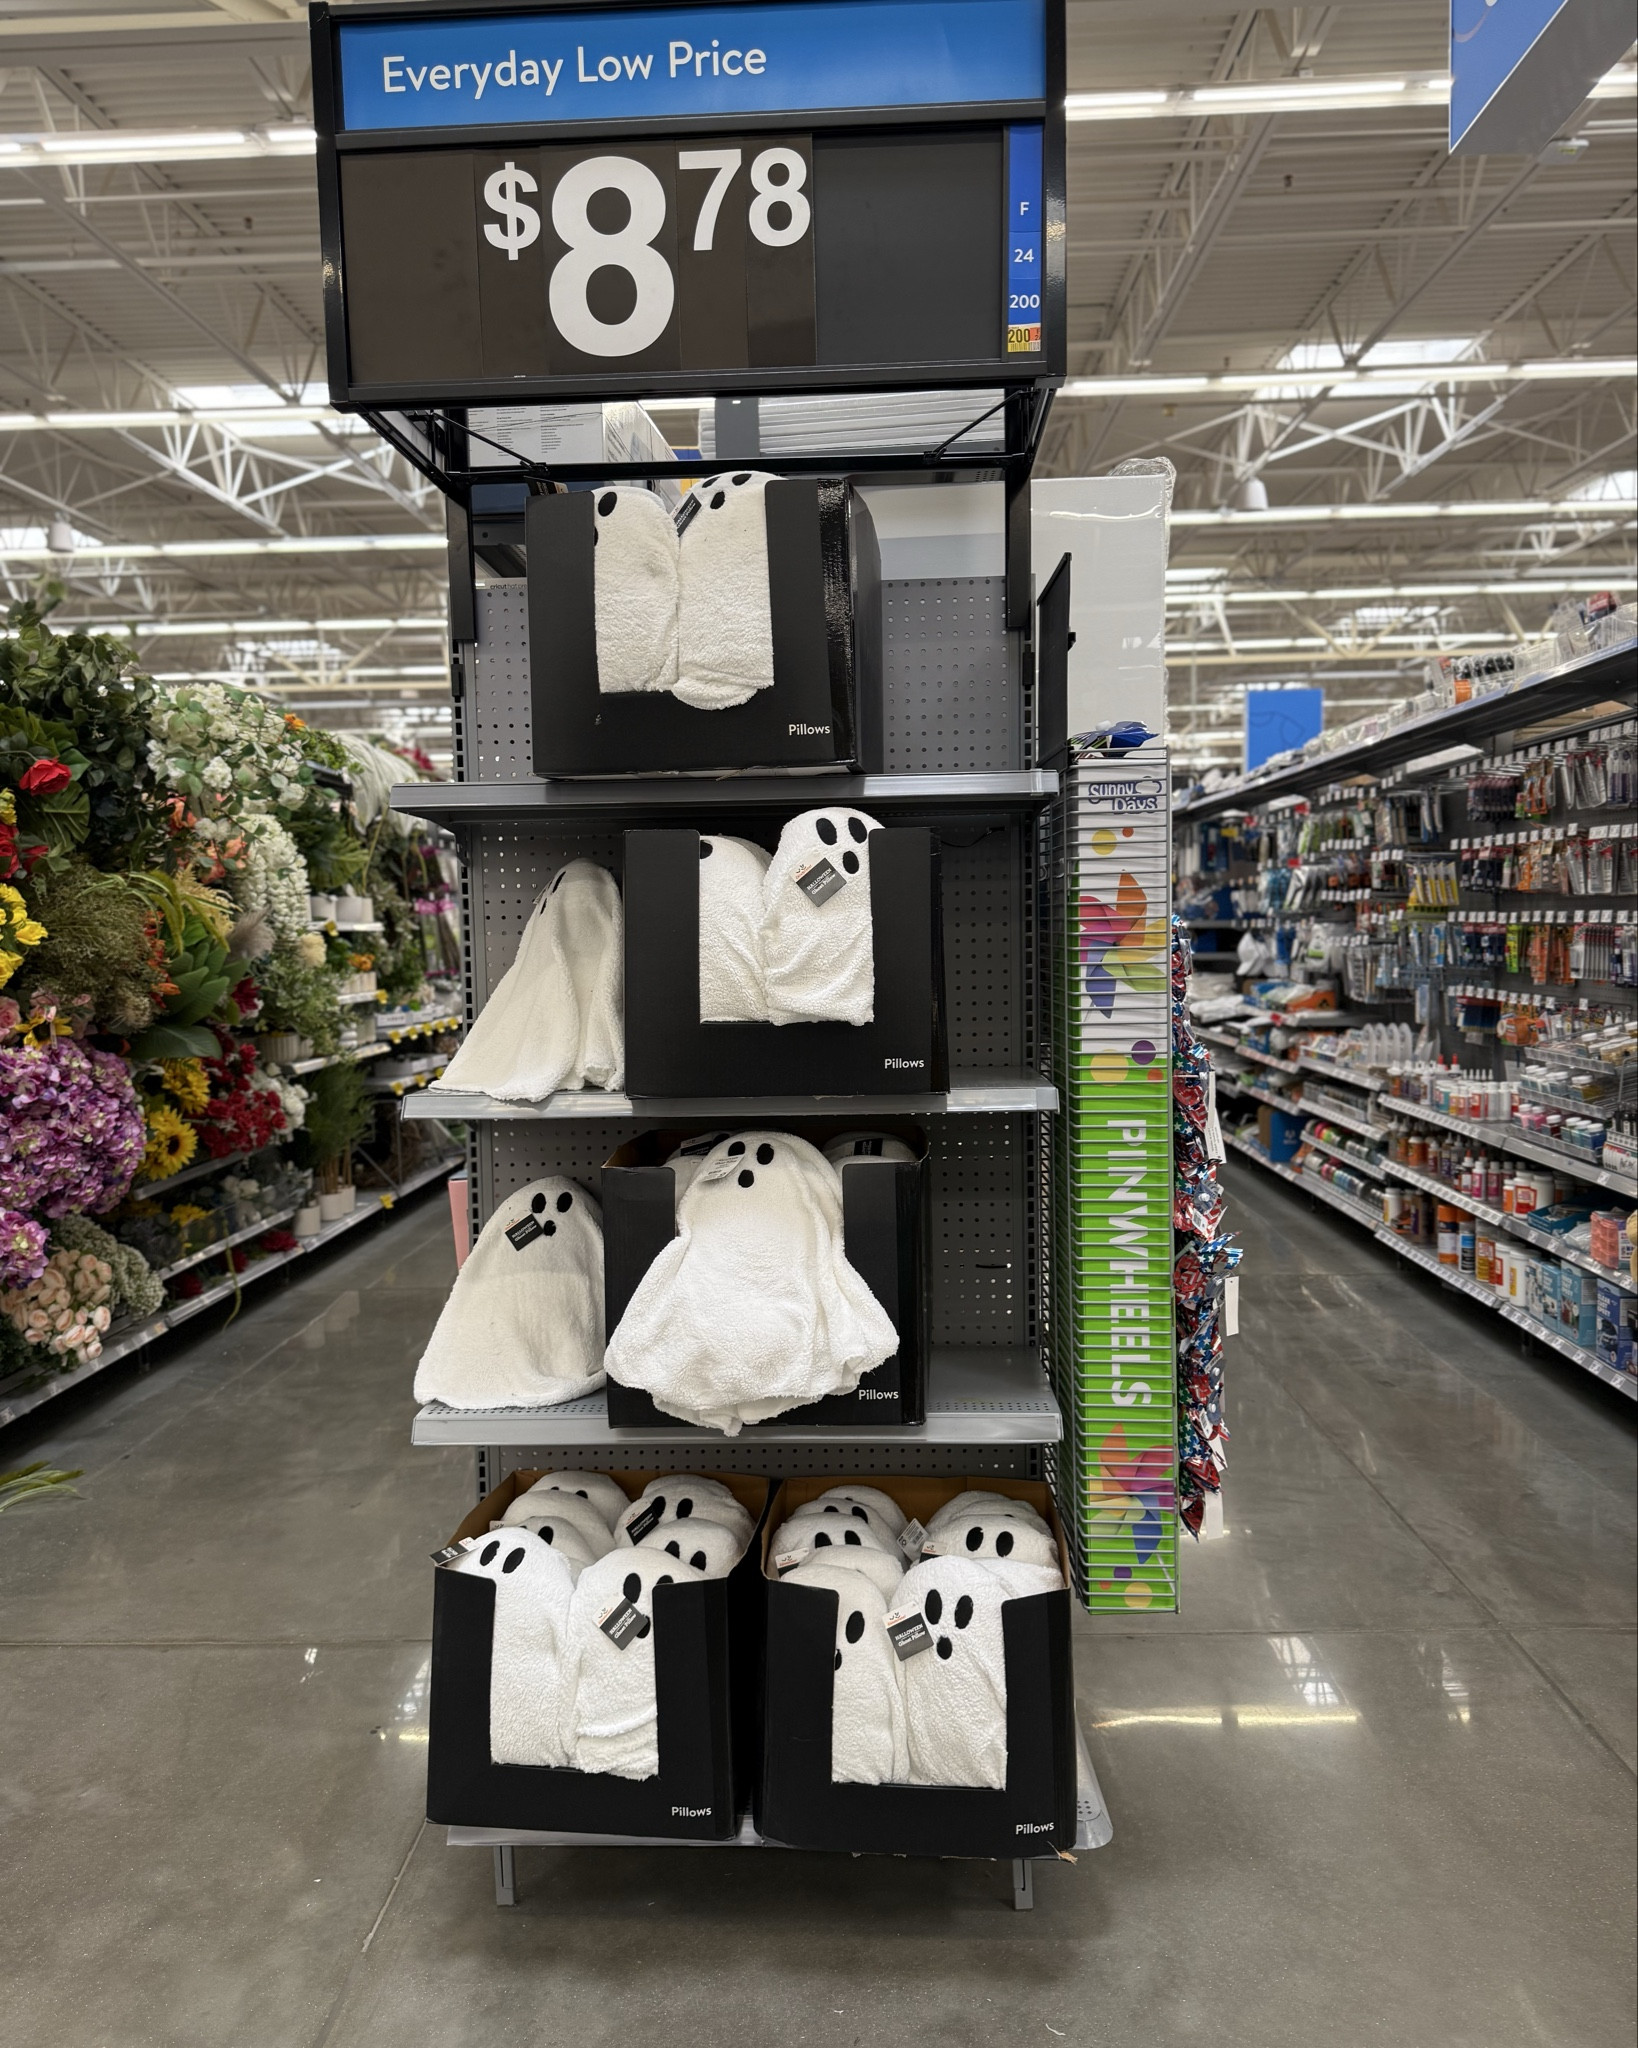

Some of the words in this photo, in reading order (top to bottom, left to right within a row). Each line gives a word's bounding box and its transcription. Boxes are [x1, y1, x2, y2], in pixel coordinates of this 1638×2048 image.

[383, 50, 563, 99] Everyday
[577, 46, 654, 83] Low
[669, 40, 767, 77] Price
[1020, 201, 1030, 216] F
[1014, 248, 1034, 263] 24
[1009, 294, 1040, 309] 200
[1008, 328, 1031, 343] 200
[788, 723, 831, 736] Pillows
[1112, 796, 1157, 814] Days
[884, 1057, 925, 1069] Pillows
[1107, 1119, 1152, 1406] PINWHEELS
[857, 1388, 899, 1400] Pillows
[608, 1607, 633, 1635] HALLOWEEN
[894, 1623, 924, 1641] HALLOWEEN
[671, 1806, 712, 1817] Pillows
[1015, 1822, 1055, 1835] Pillows
